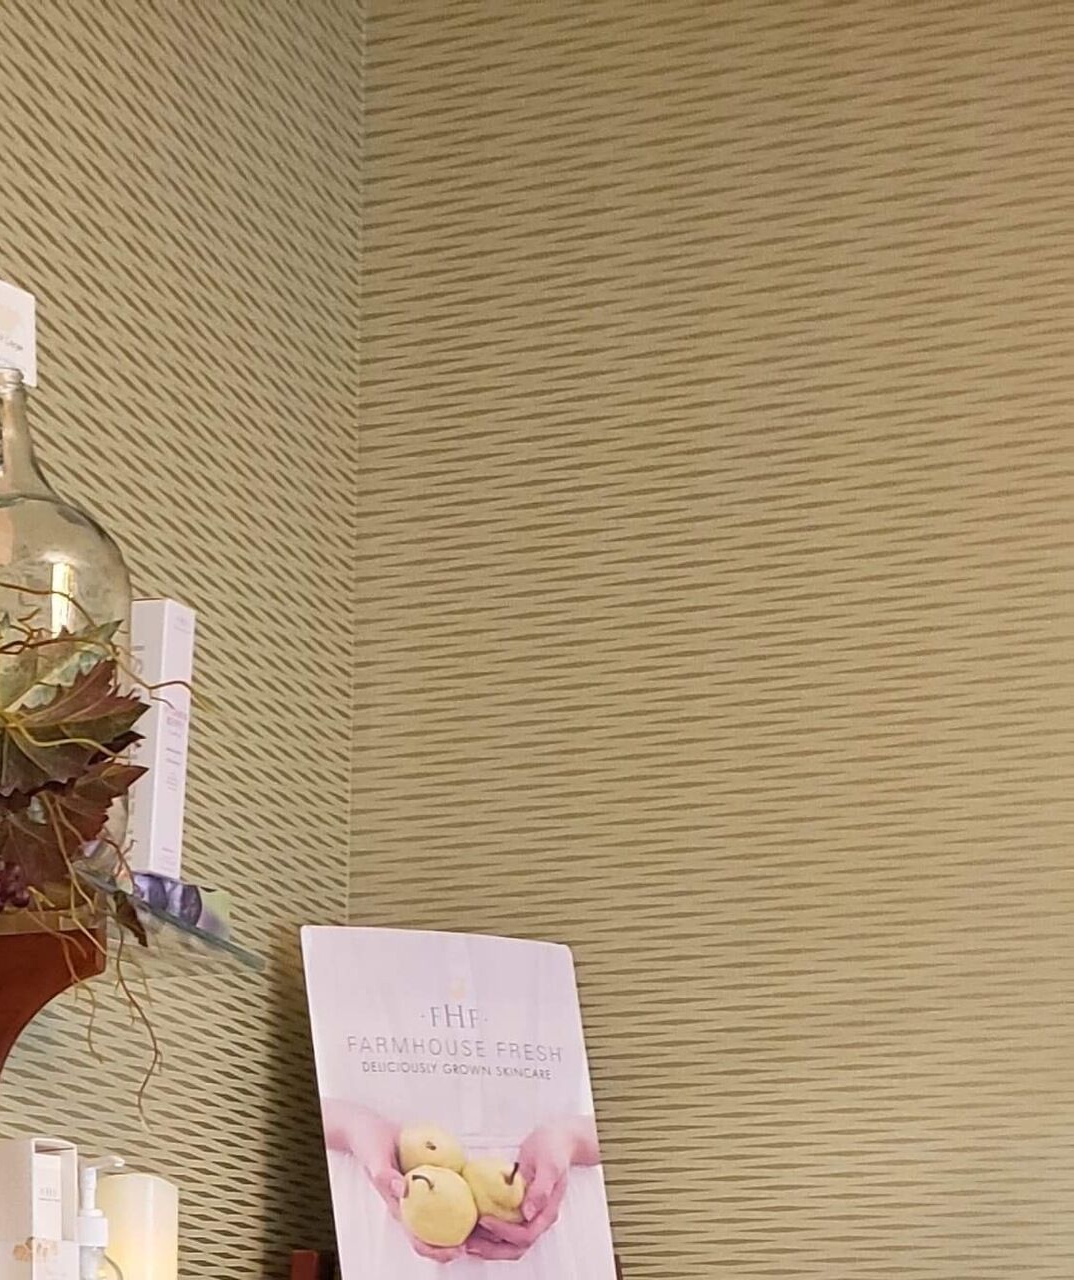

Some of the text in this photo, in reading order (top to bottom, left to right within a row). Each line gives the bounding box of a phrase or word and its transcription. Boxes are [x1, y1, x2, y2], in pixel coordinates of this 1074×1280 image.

[429, 1003, 480, 1028] FHF
[346, 1036, 563, 1063] FARMHOUSE FRESH
[361, 1060, 551, 1081] DELICIOUSLY GROWN SKINCARE
